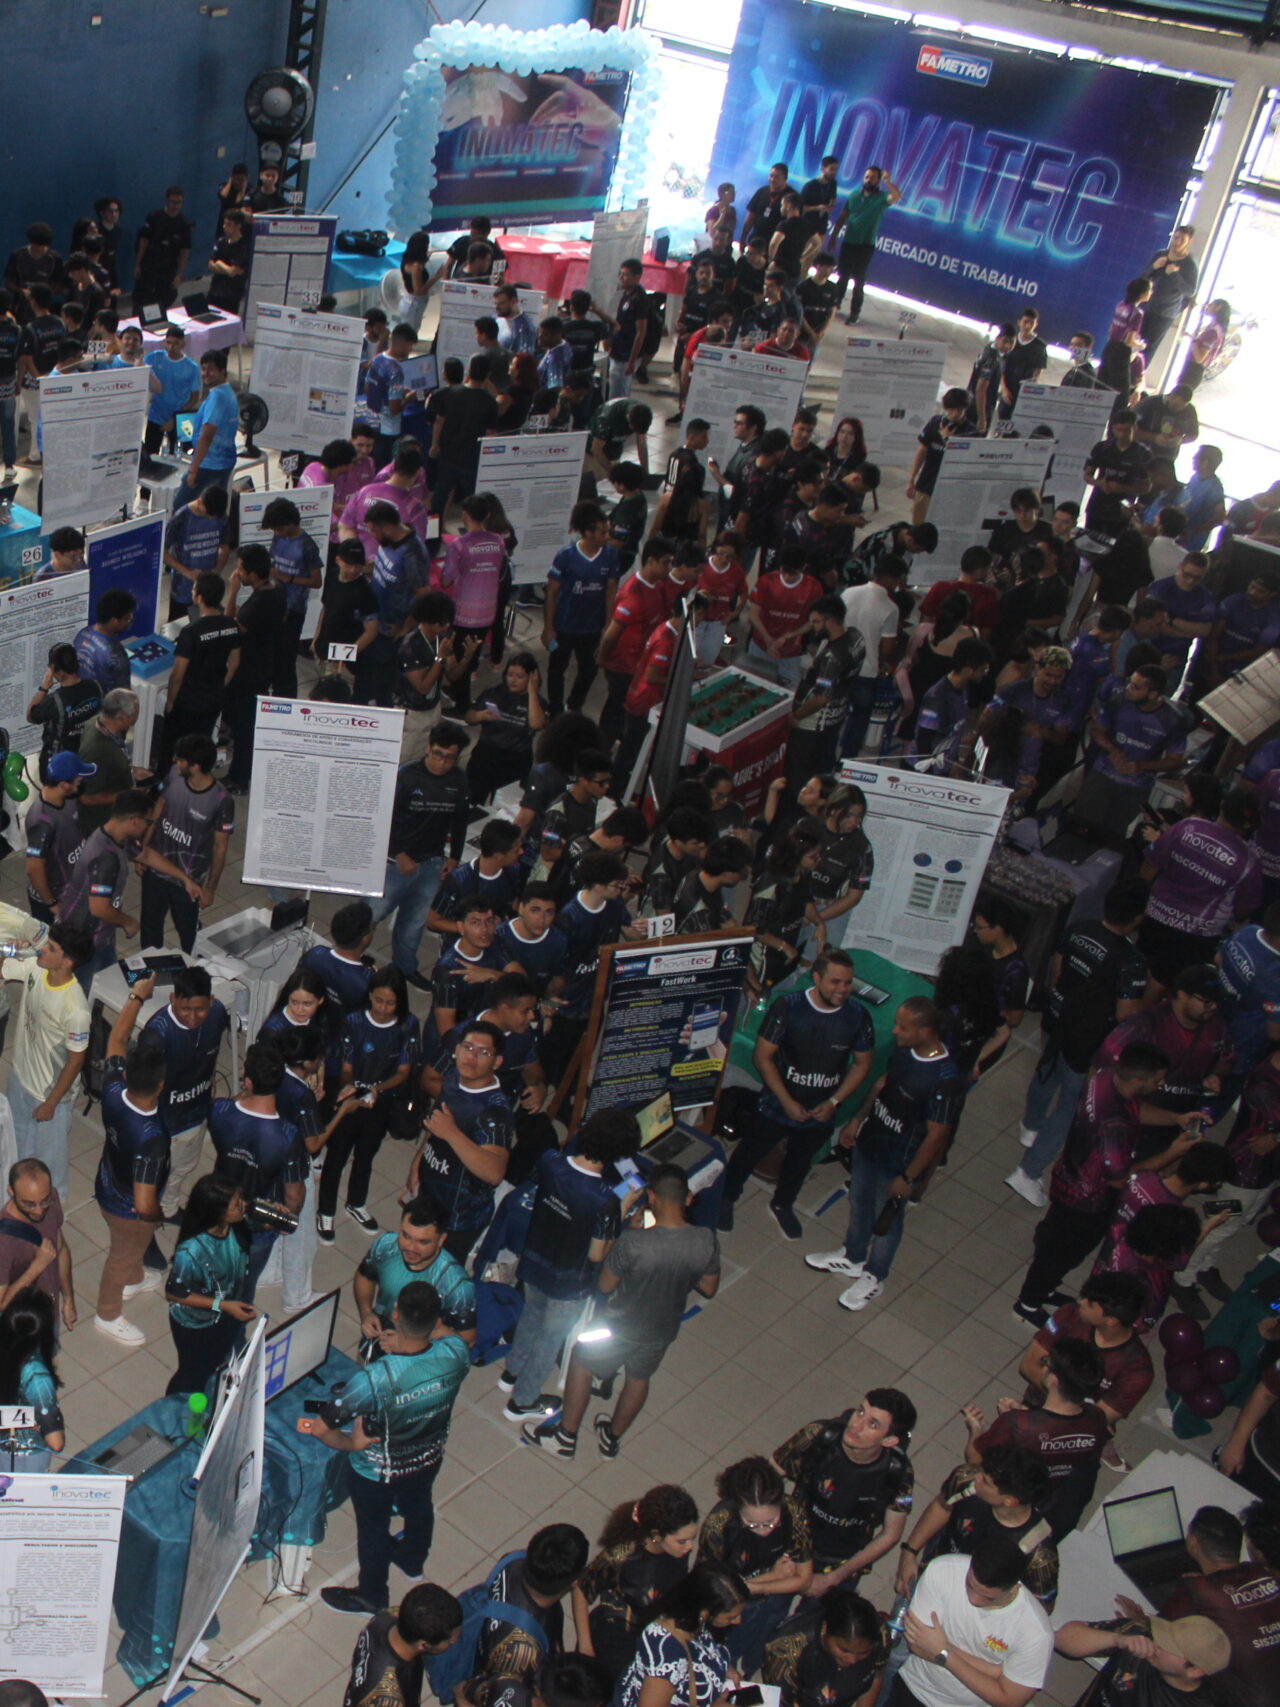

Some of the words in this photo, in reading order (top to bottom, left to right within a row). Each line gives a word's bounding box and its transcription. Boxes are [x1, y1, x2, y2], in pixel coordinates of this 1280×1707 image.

[918, 48, 990, 82] FAMETRO
[757, 79, 1121, 260] INOVATEC
[825, 219, 846, 238] PAR
[874, 236, 938, 266] MERCADO
[940, 253, 960, 271] DE
[962, 261, 1039, 296] TRABALHO
[301, 291, 320, 305] 33
[88, 343, 108, 355] 32
[23, 548, 42, 562] 26
[330, 645, 355, 659] 17
[302, 711, 380, 729] inovatec
[890, 781, 983, 806] inovatec
[1181, 831, 1237, 867] inovatec
[650, 916, 674, 938] 12
[1069, 934, 1106, 962] inovate
[655, 955, 713, 971] inovatec
[661, 975, 697, 987] FastWork
[787, 1065, 841, 1089] FastWork
[169, 1080, 211, 1105] FastWo
[1040, 1435, 1096, 1451] inovatec
[50, 1485, 112, 1500] inovatec
